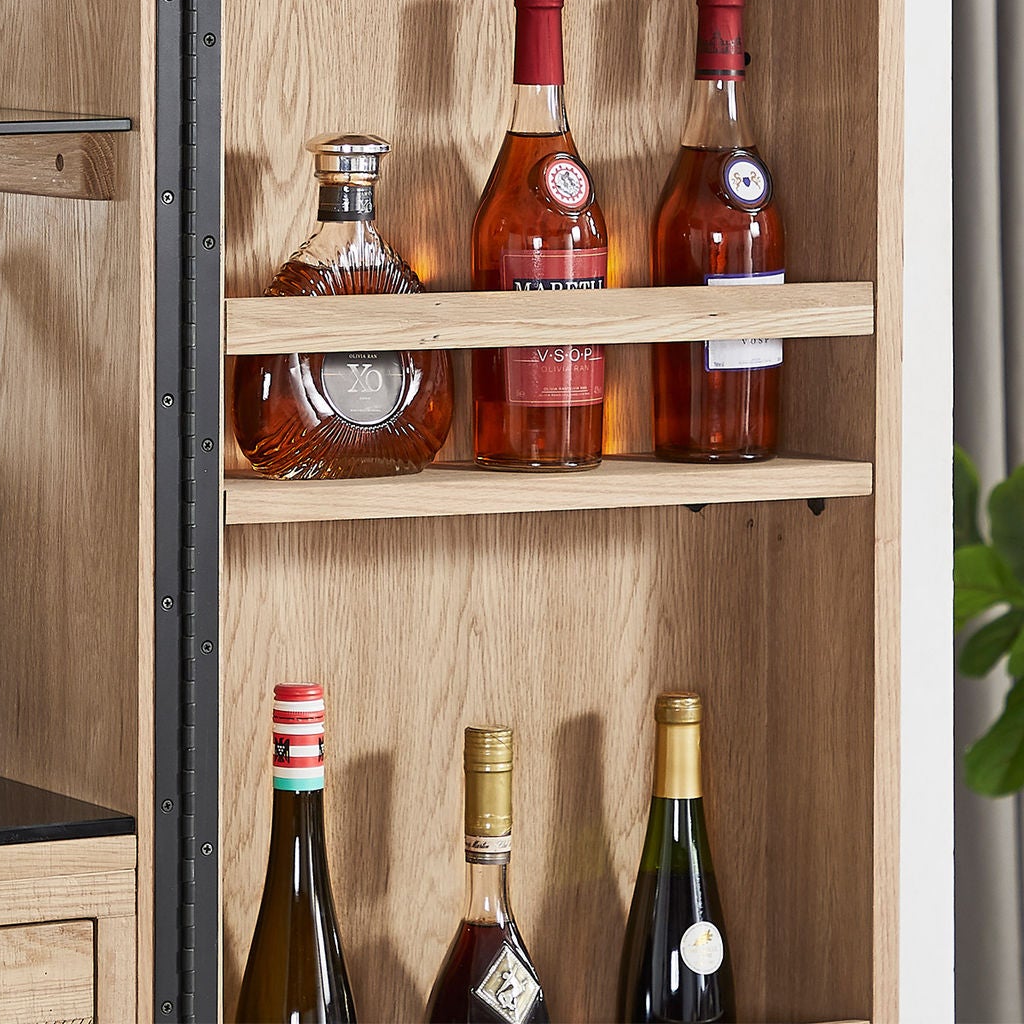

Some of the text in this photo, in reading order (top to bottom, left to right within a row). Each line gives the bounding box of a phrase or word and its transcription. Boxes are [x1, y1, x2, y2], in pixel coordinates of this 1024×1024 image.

[346, 363, 383, 393] XO
[541, 364, 589, 373] OLIVIA RAN
